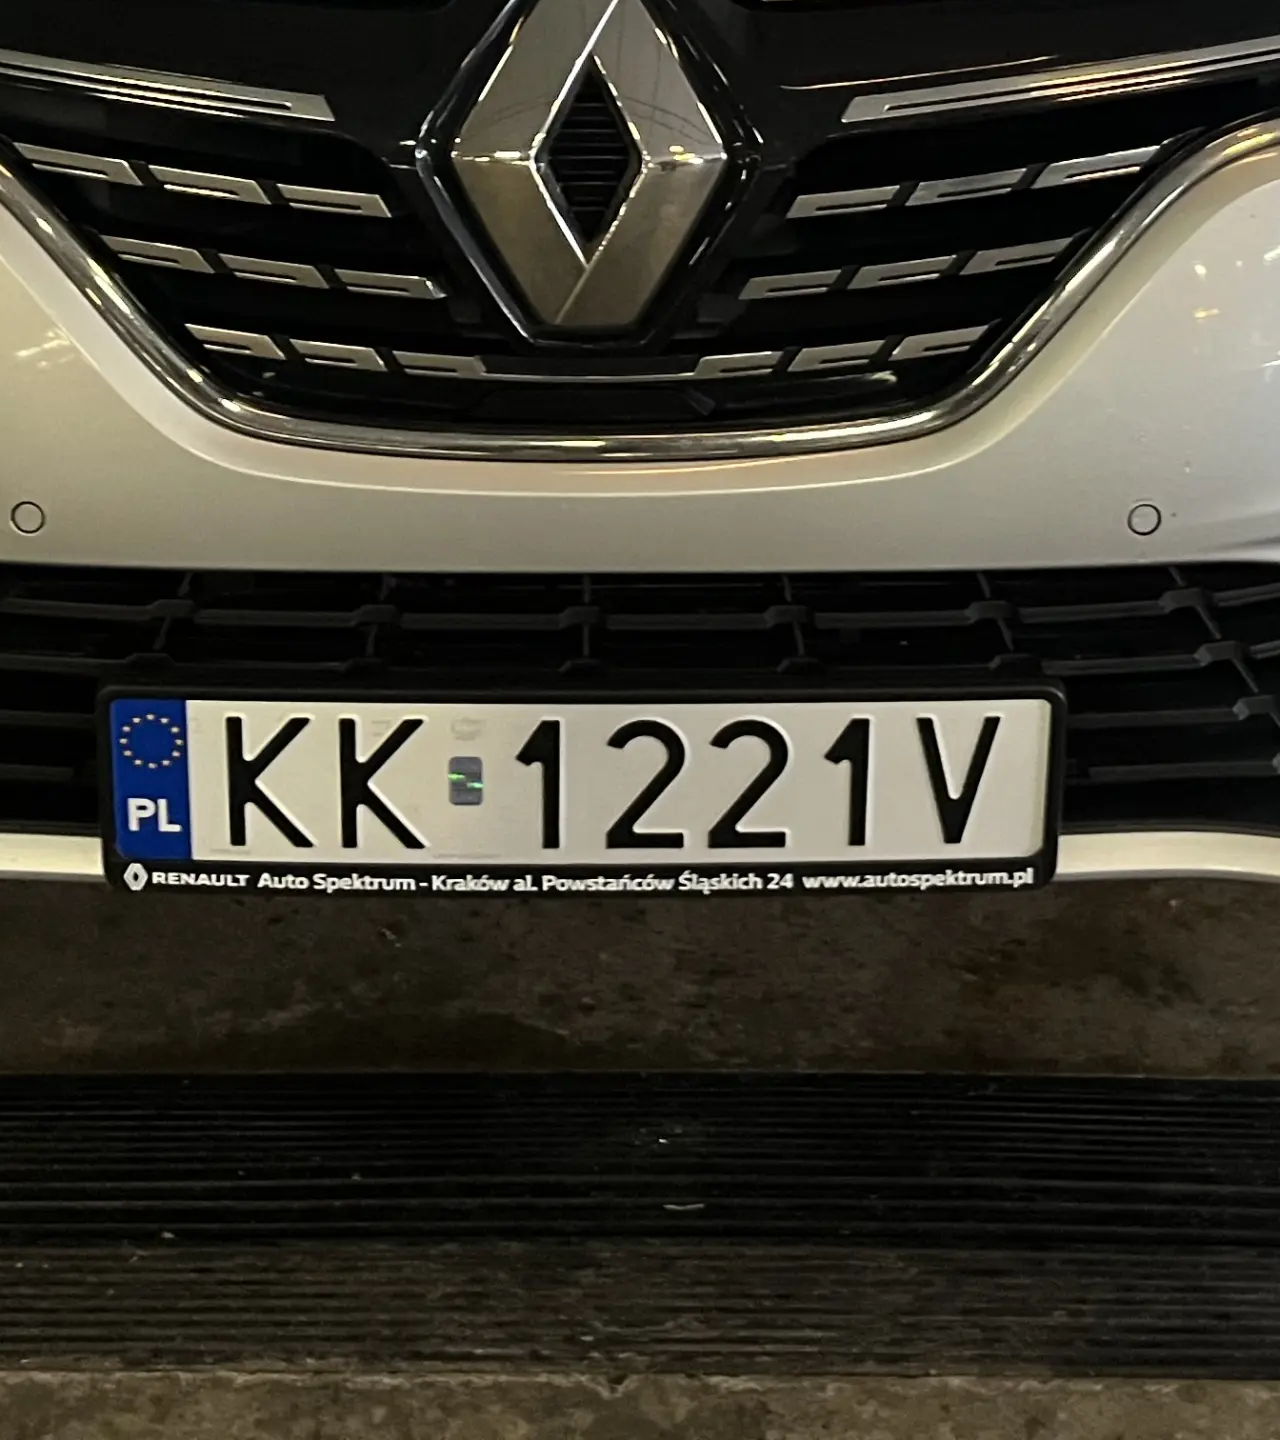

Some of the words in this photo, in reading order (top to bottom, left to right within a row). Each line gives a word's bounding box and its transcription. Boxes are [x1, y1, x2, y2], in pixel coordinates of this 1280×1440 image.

[227, 716, 424, 850] KK
[515, 716, 1001, 850] 1221V
[127, 797, 182, 833] PL
[151, 871, 250, 887] RENAULT
[257, 872, 309, 890] Auto
[313, 872, 416, 894] Spektrum
[431, 874, 510, 892] Kraków
[541, 872, 676, 892] Powstańców
[678, 869, 763, 895] Śląskich
[766, 872, 794, 890] 24
[801, 867, 1034, 891] www.autospektrum.pl
